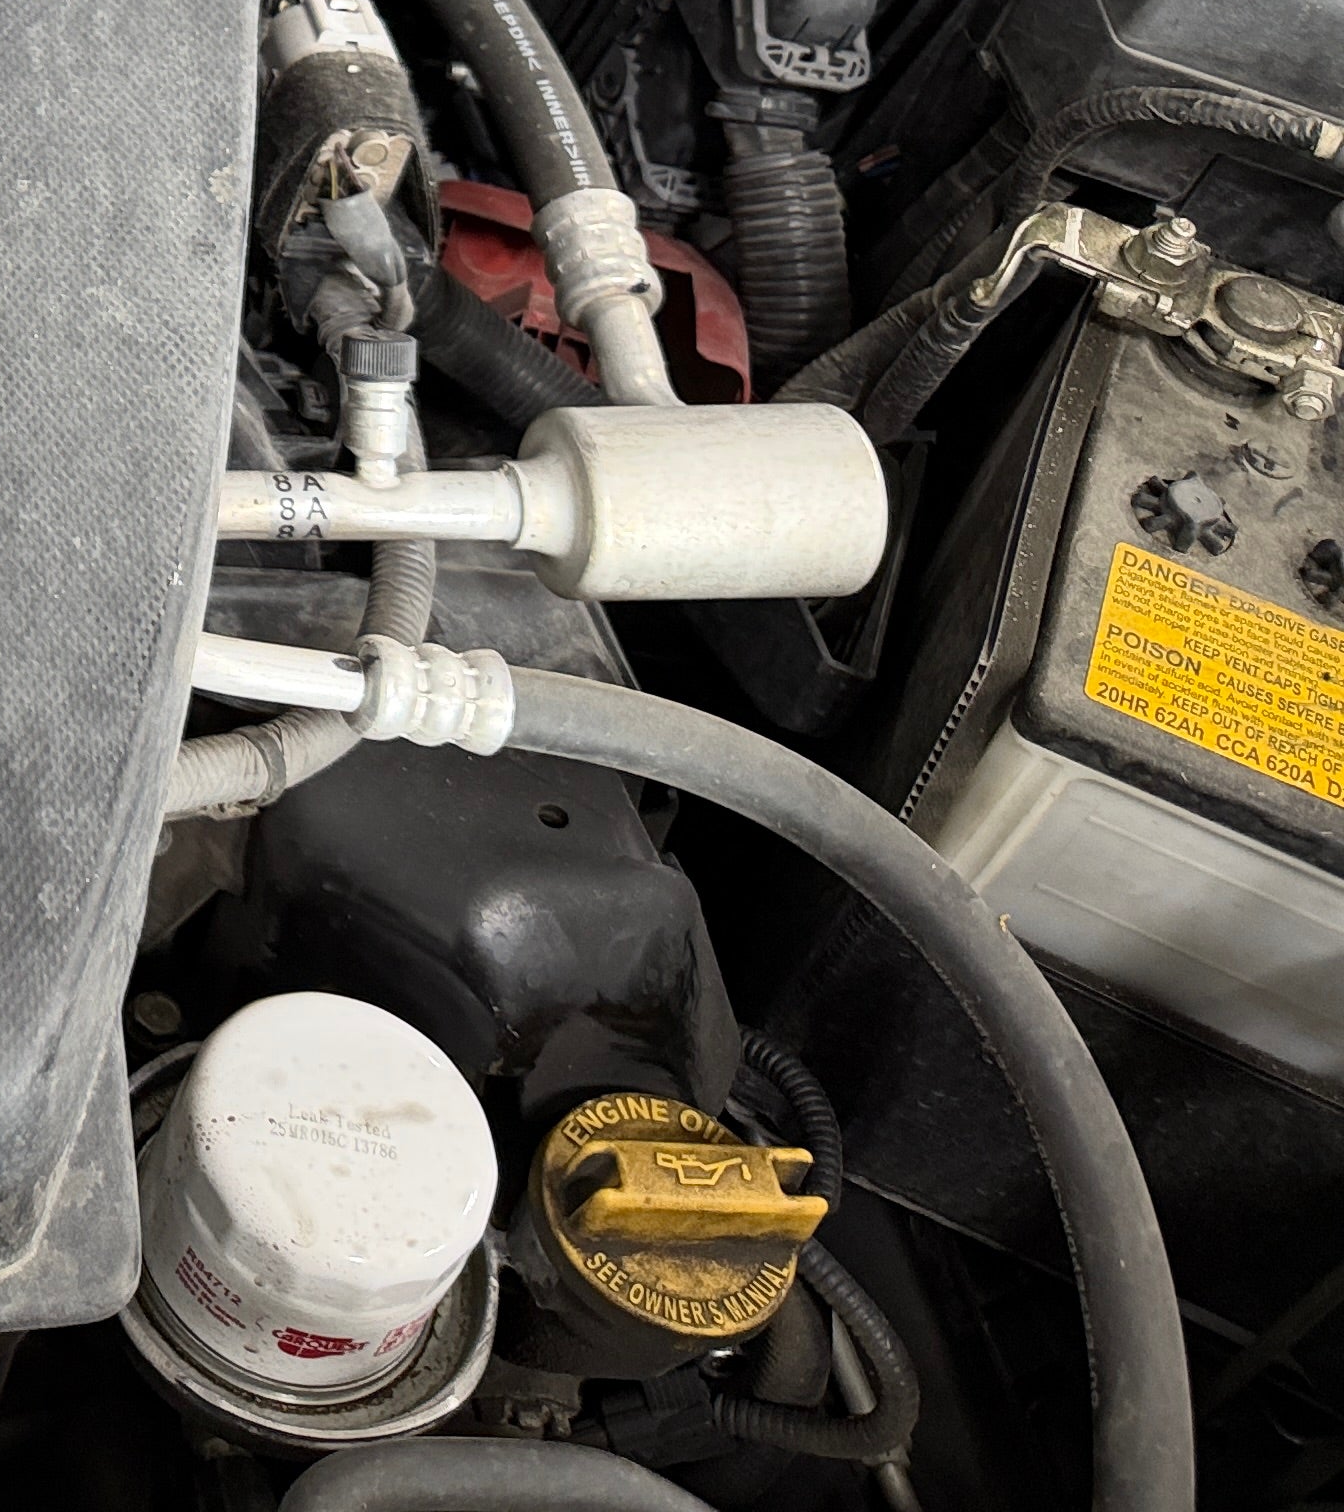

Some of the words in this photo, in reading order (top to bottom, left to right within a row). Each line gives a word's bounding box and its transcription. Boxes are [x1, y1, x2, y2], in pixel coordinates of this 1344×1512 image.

[1112, 595, 1150, 616] without
[1155, 614, 1188, 635] proper
[1193, 629, 1248, 658] instruction
[1253, 654, 1272, 668] and
[1115, 585, 1129, 597] Do
[1134, 593, 1150, 606] not
[1154, 602, 1190, 624] charge
[1210, 626, 1227, 638] use
[1277, 653, 1312, 674] cables
[1117, 575, 1154, 598] Always
[1159, 592, 1189, 611] shield
[1194, 608, 1218, 625] eyes
[1223, 619, 1242, 633] and
[1248, 629, 1269, 645] face
[1274, 640, 1298, 656] from
[1123, 550, 1220, 602] DANGER
[1230, 595, 1305, 636] EXPLOSIVE
[1107, 624, 1201, 675] POISON
[1217, 671, 1273, 705] CAUSES
[1278, 697, 1333, 730] SEVERE
[1184, 637, 1219, 661] KEEP
[1224, 653, 1259, 678] VENT
[1264, 670, 1301, 695] CAPS
[1274, 630, 1302, 648] could
[1103, 639, 1151, 667] Contains
[1156, 661, 1194, 685] sulfuric
[1227, 693, 1257, 712] Avoid
[1262, 708, 1301, 731] contact
[1307, 726, 1329, 743] with
[1115, 657, 1144, 676] event
[1163, 677, 1207, 703] accident
[1213, 698, 1237, 716] flush
[1243, 711, 1263, 728] with
[1269, 723, 1298, 742] water
[1097, 680, 1149, 716] 20HR
[1155, 705, 1204, 740] 62Ah
[1216, 732, 1262, 765] CCA
[1266, 753, 1316, 788] 620A
[1171, 693, 1208, 719] KEEP
[1213, 711, 1240, 733] OUT
[1245, 725, 1263, 743] OF
[1269, 735, 1317, 766] REACH
[1322, 757, 1342, 776] OF
[287, 1101, 330, 1124] Leak
[335, 1112, 392, 1140] Tested
[353, 1135, 398, 1161] 13786
[563, 1096, 670, 1147] ENGINE
[585, 1251, 629, 1293] SEE
[628, 1282, 725, 1326] OWNER'S
[722, 1261, 790, 1323] MANUAL
